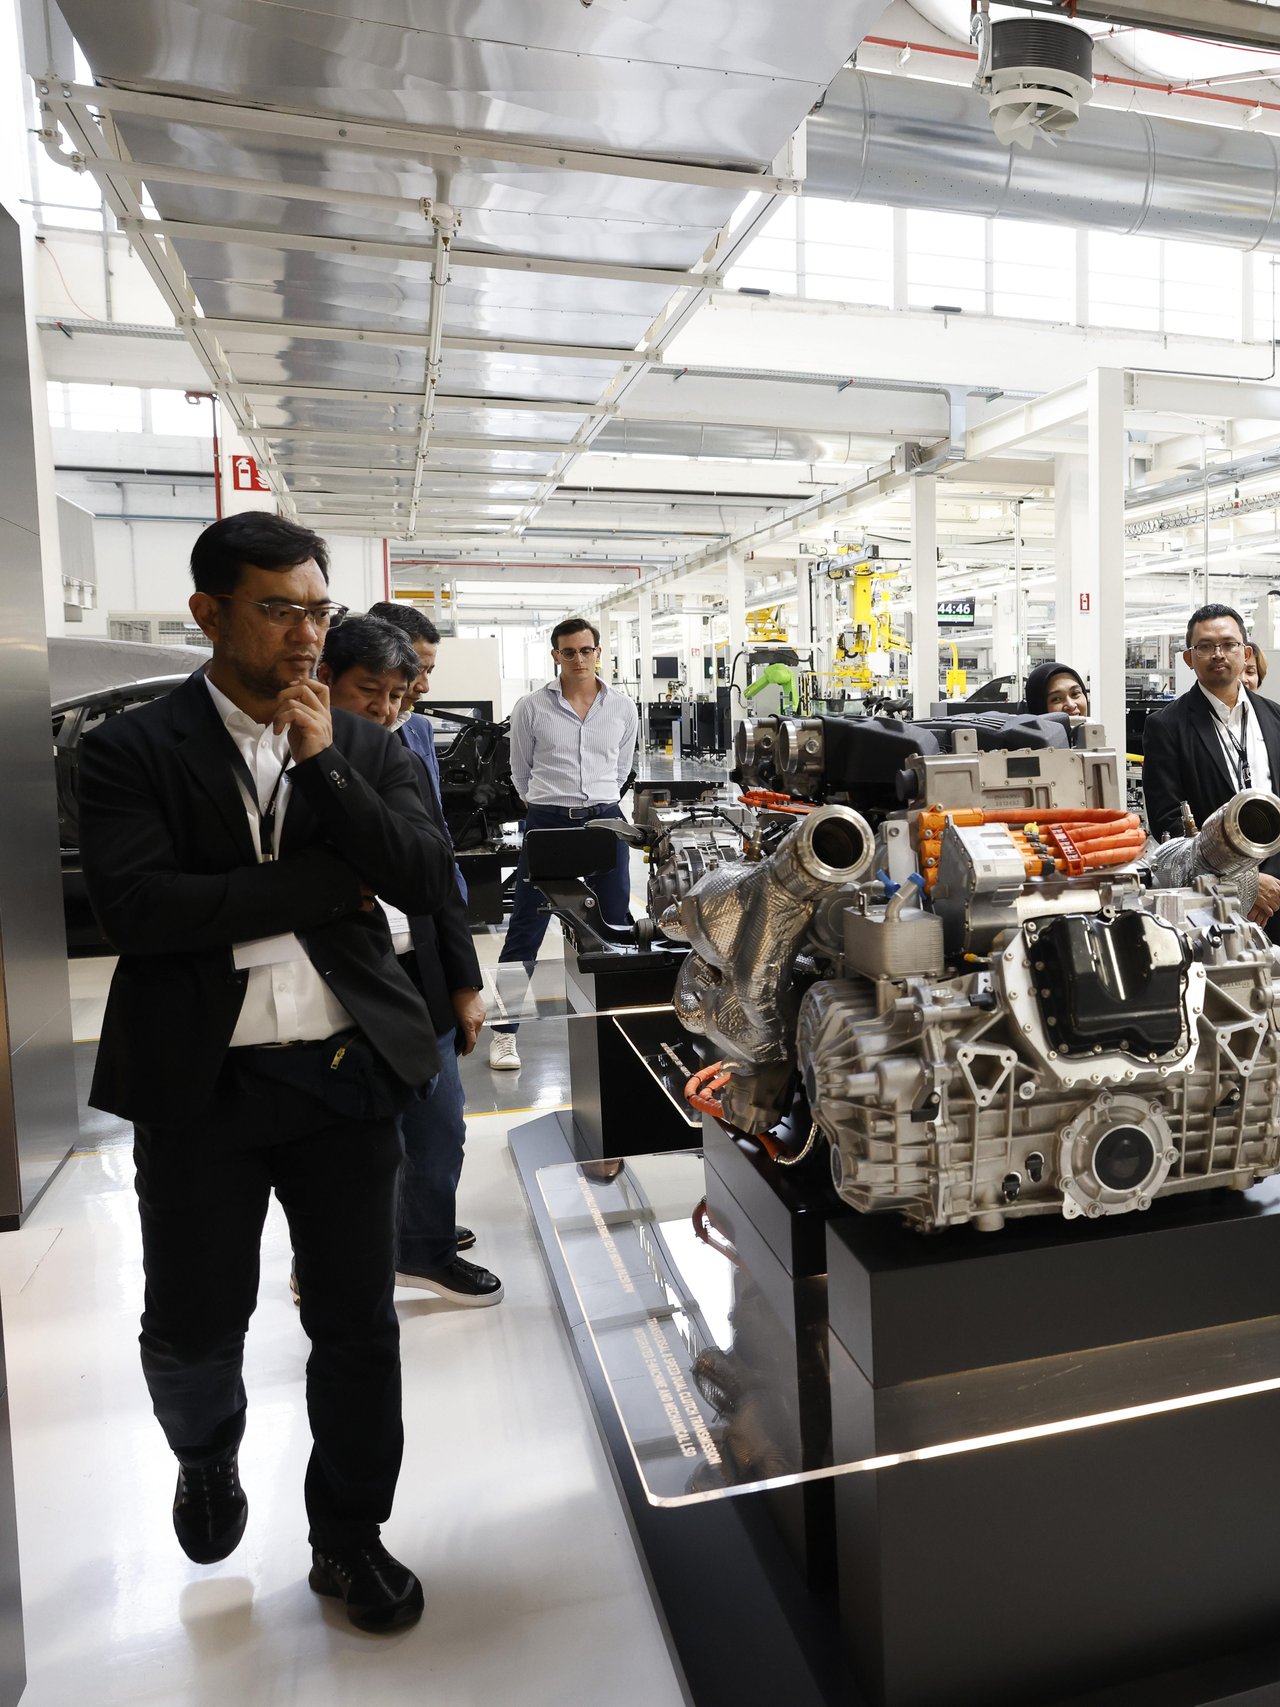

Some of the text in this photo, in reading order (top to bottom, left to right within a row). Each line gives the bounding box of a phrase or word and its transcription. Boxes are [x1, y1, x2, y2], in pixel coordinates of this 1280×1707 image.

[938, 603, 970, 614] 44:46
[672, 1375, 688, 1392] DUAL
[658, 1388, 673, 1403] AND
[679, 1391, 699, 1415] CLUTCH
[663, 1401, 691, 1443] MECHANICAL
[689, 1414, 722, 1465] TRANSMISSION
[679, 1441, 697, 1458] LSD
